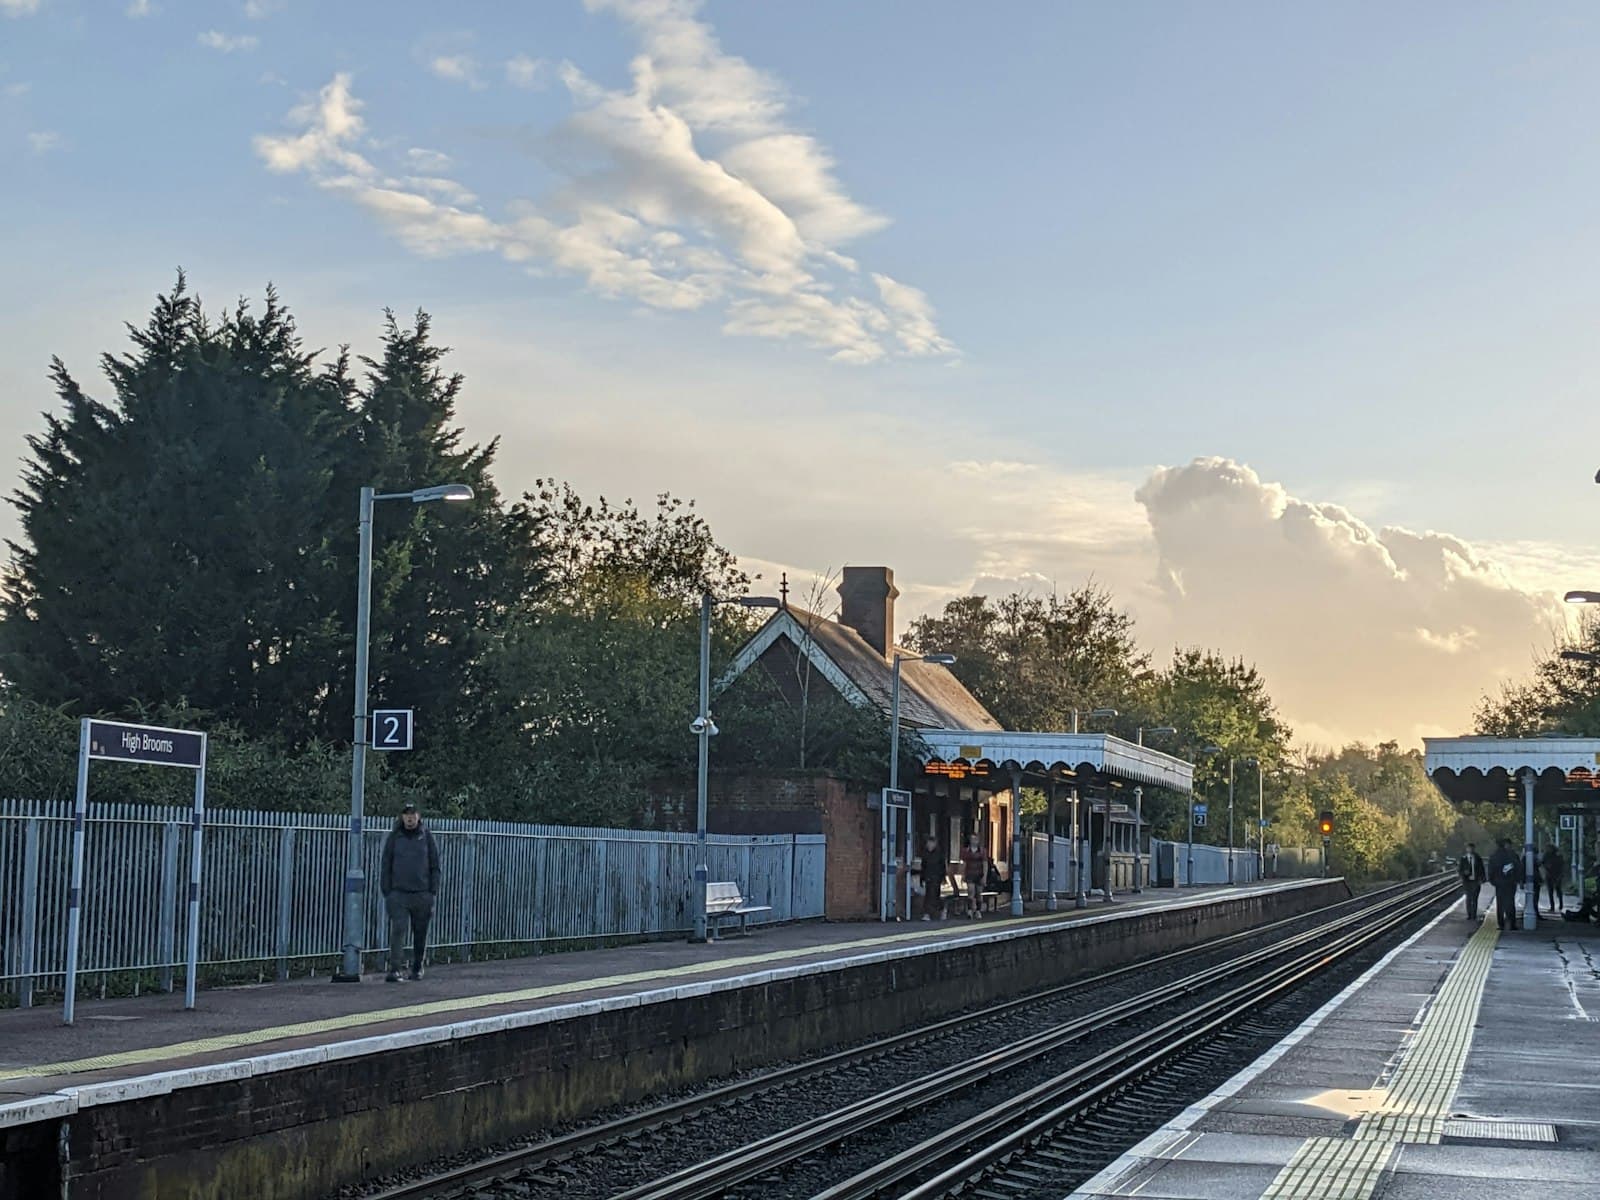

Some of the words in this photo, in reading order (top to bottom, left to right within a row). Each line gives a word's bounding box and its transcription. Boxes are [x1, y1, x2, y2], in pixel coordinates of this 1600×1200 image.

[383, 716, 399, 743] 2
[121, 731, 141, 753] High
[142, 733, 174, 753] Brooms
